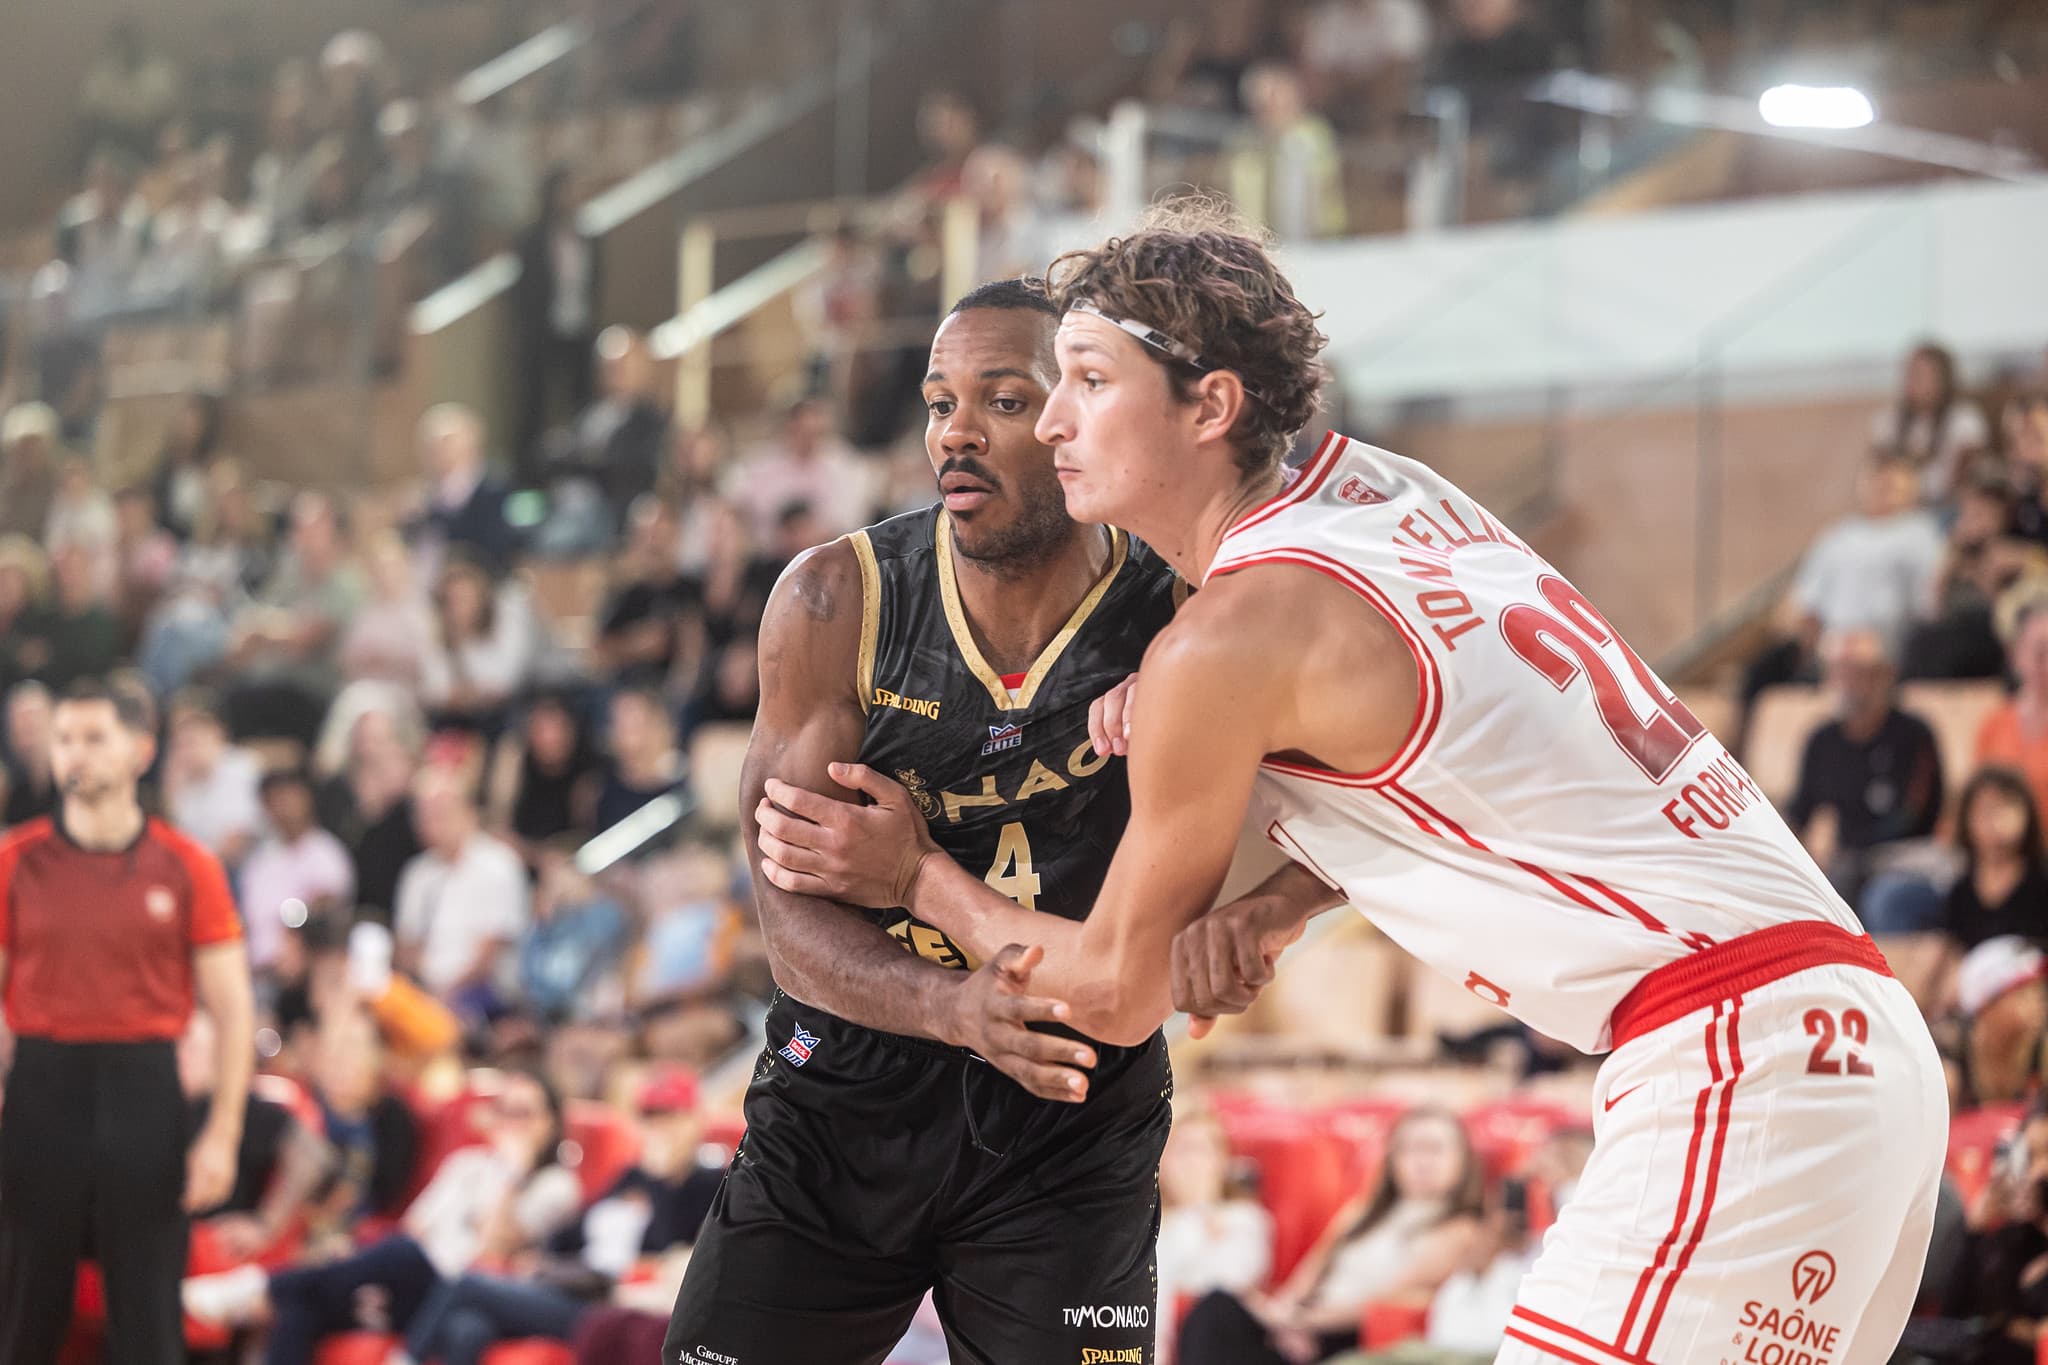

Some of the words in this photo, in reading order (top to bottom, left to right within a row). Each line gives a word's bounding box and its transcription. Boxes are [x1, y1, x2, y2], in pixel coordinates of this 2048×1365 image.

[1498, 573, 1708, 786] 22
[872, 688, 941, 720] SPALDING
[983, 735, 1021, 754] ELITE
[984, 821, 1041, 912] 4
[780, 1047, 805, 1067] ELITE
[1802, 1007, 1875, 1078] 22
[1739, 1301, 1840, 1353] SAÔNE
[1081, 1346, 1142, 1365] SPALDING
